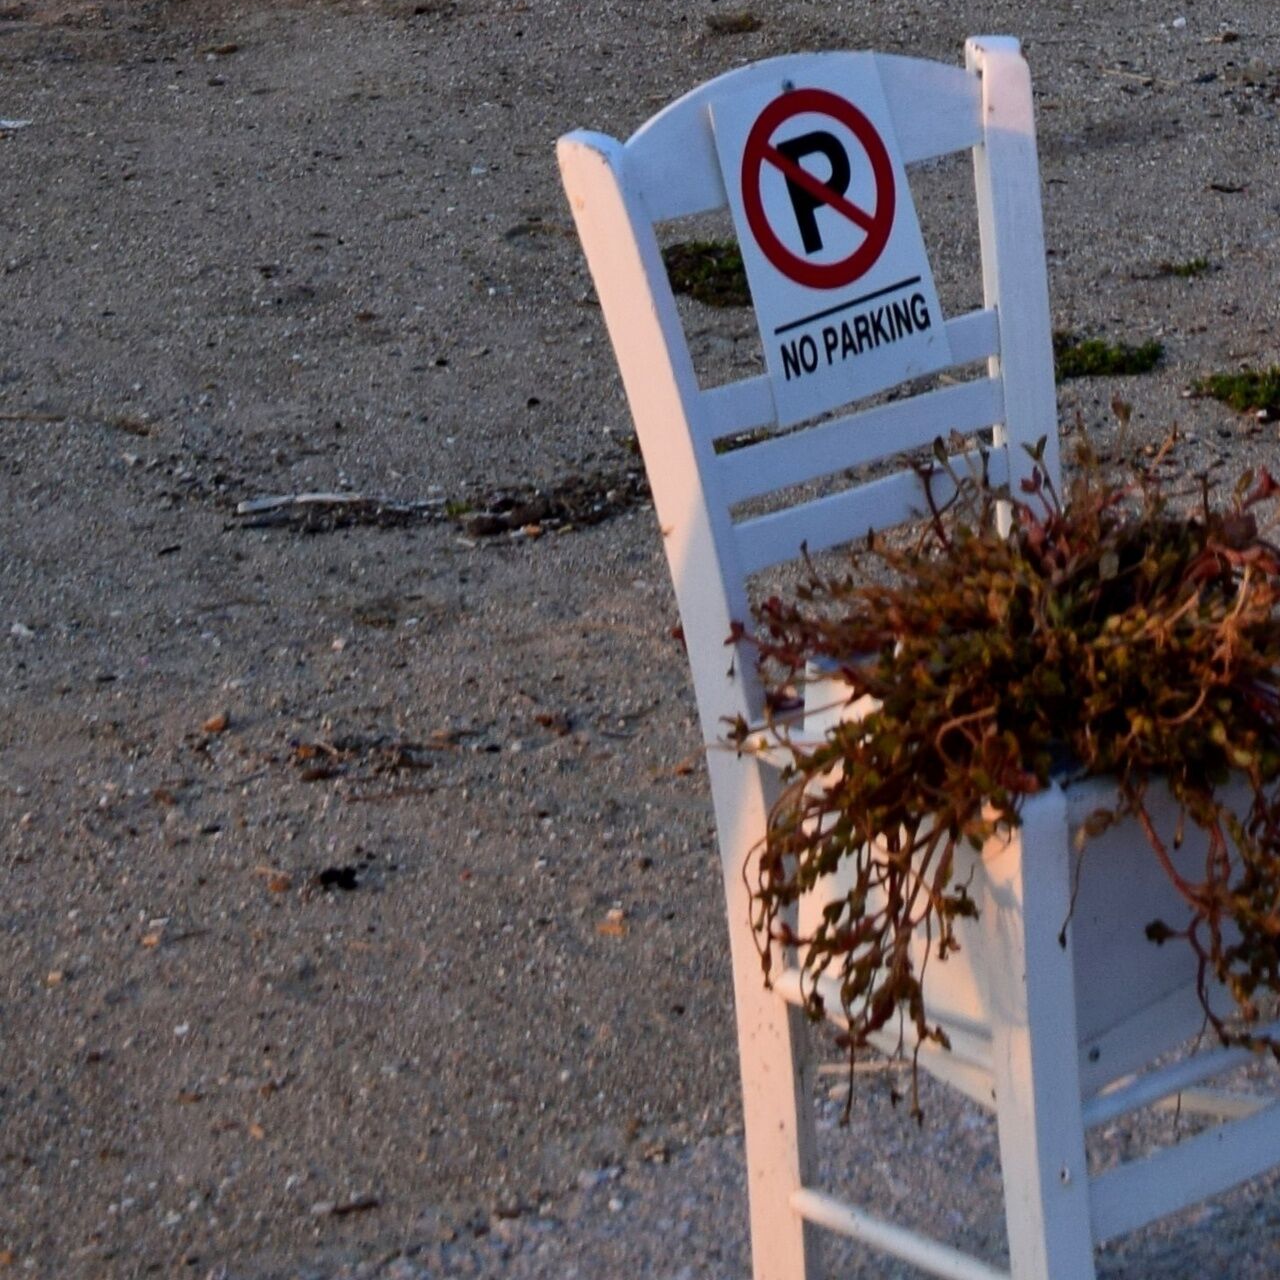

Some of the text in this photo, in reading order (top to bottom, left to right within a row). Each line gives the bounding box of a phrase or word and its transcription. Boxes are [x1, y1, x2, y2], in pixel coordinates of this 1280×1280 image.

[776, 130, 851, 255] P
[780, 293, 931, 381] NO PARKING
